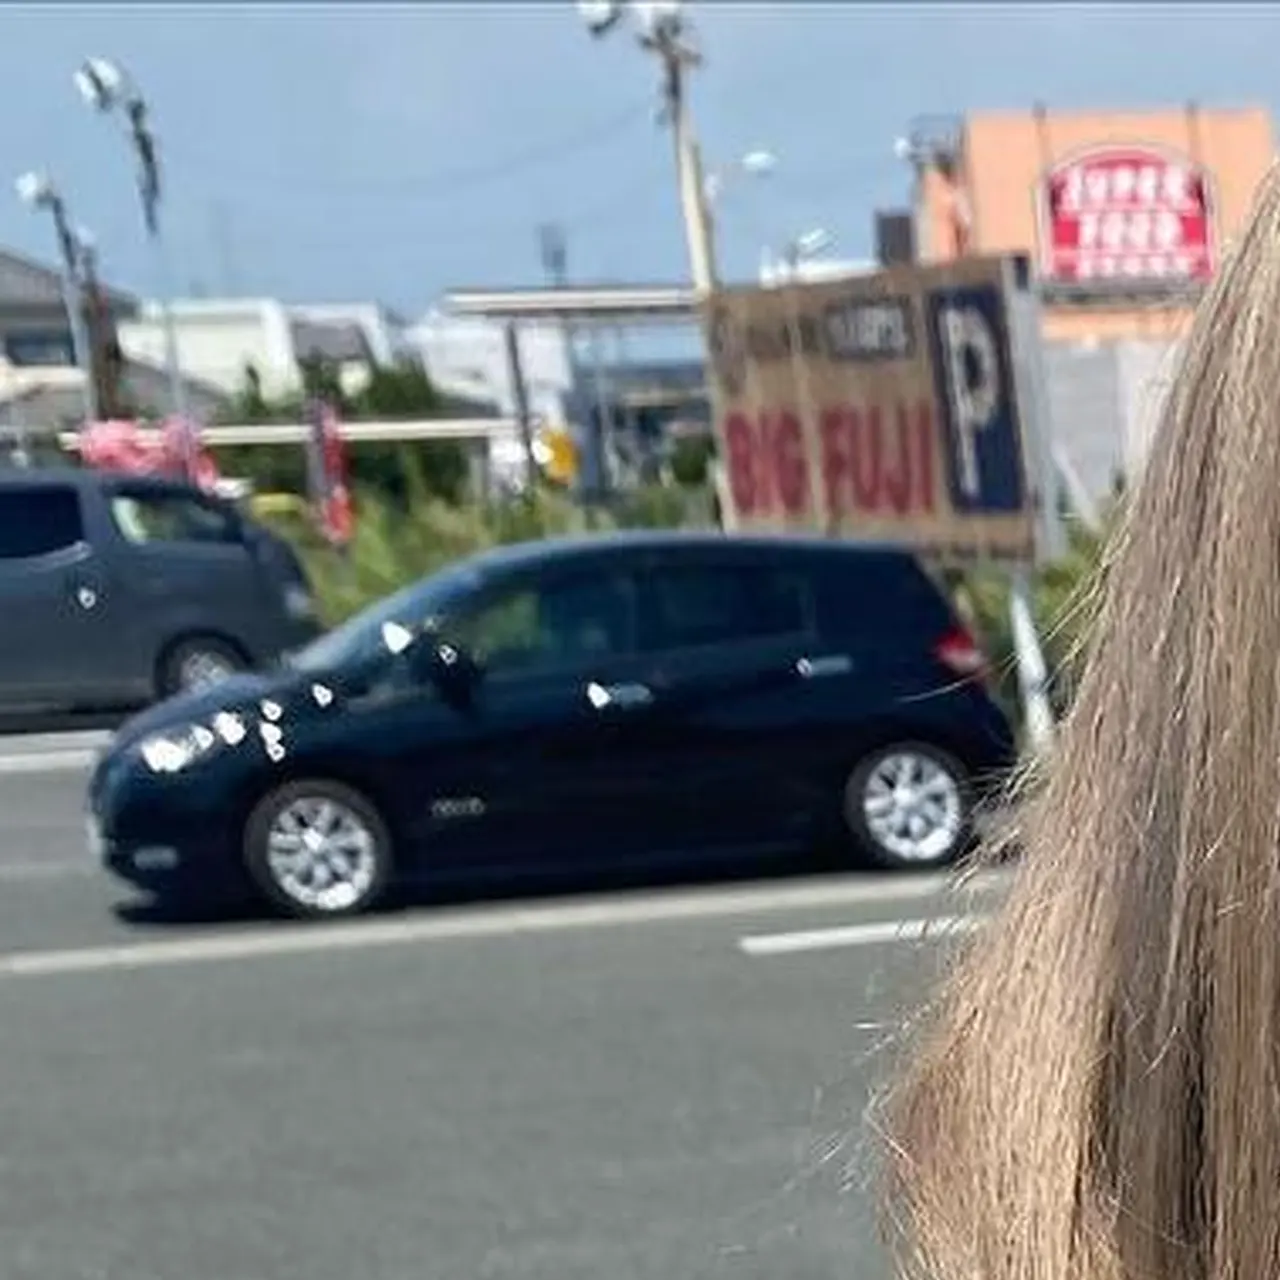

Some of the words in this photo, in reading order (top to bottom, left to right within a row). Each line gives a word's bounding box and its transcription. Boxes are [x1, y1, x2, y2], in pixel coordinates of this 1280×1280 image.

[726, 409, 806, 514] BIG
[820, 403, 935, 514] FUJI
[939, 307, 998, 496] P
